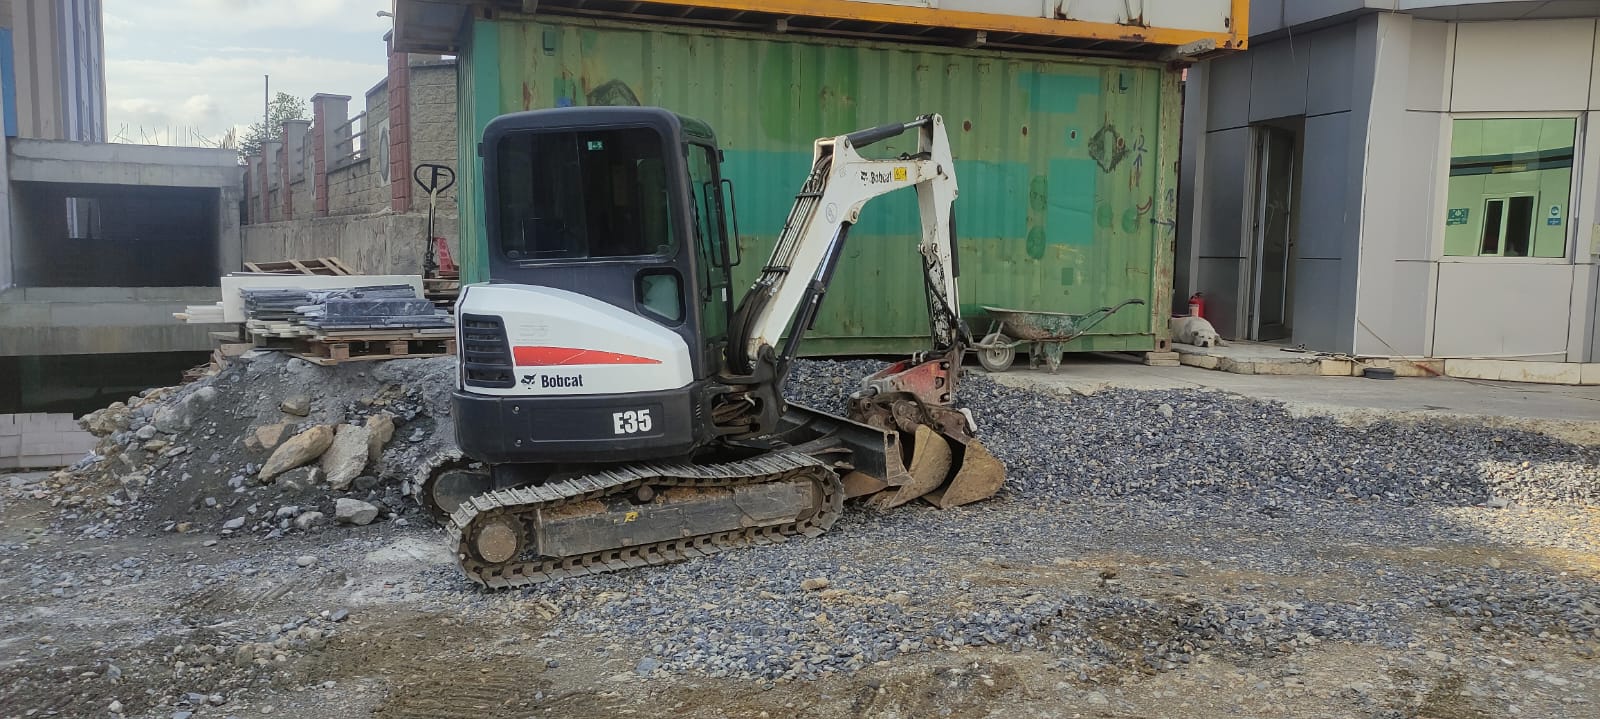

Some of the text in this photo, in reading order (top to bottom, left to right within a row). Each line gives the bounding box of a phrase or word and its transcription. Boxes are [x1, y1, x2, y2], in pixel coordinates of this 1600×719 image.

[870, 171, 892, 184] Bobcat
[541, 374, 583, 388] Bobcat
[613, 409, 652, 435] E35
